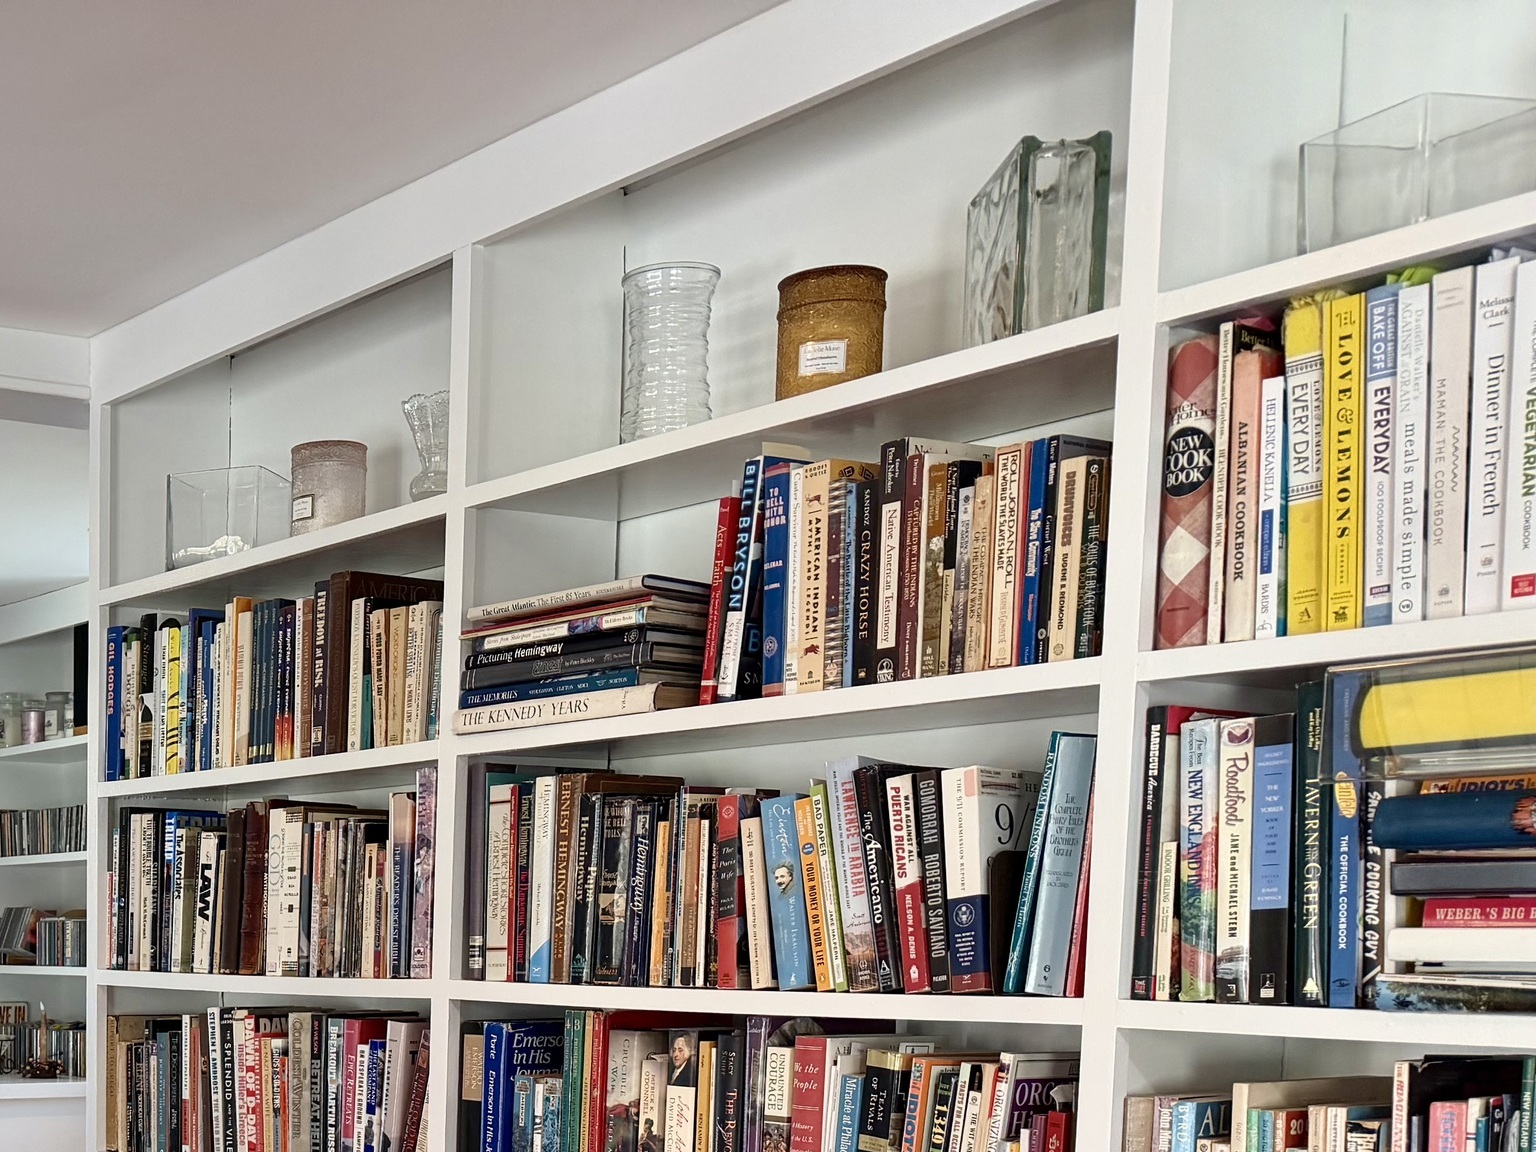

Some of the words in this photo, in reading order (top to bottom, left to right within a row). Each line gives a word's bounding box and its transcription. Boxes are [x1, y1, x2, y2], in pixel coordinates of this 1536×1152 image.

[1373, 306, 1385, 339] BAKE
[1483, 308, 1509, 319] Clark
[1338, 334, 1353, 402] LOVE
[1373, 341, 1385, 370] OFF
[1292, 383, 1309, 435] EVERY
[1486, 354, 1505, 421] Dinner
[1337, 408, 1353, 425] &
[1373, 386, 1390, 475] EVERYDAY
[1485, 426, 1503, 443] in
[1166, 449, 1213, 474] COOK
[1171, 434, 1203, 453] NEW
[1237, 421, 1248, 496] ALBANIAN
[1294, 442, 1309, 474] DAY
[1403, 423, 1419, 474] meals
[742, 465, 756, 509] BILL
[1166, 468, 1205, 487] BOOK
[1336, 428, 1352, 540] LEMONS
[1403, 480, 1417, 526] made
[1482, 450, 1502, 517] French
[888, 509, 897, 533] Native
[1233, 502, 1246, 581] COOKBOOK
[728, 516, 750, 609] BRYSON
[814, 516, 822, 581] AMERICAN
[861, 531, 872, 582] CRAZY
[885, 537, 897, 591] American
[1397, 532, 1416, 590] simple
[812, 586, 820, 633] INDIAN
[858, 586, 870, 640] HORSE
[880, 592, 894, 643] Testimony
[477, 652, 512, 665] Picturing
[514, 643, 564, 659] Hemingway
[106, 664, 115, 717] HODGES
[462, 713, 484, 726] THE
[487, 706, 545, 725] KENNEDY
[551, 698, 590, 715] YEARS
[560, 780, 571, 836] ERNEST
[813, 799, 823, 820] BAD
[890, 786, 904, 832] PUERTO
[919, 779, 938, 844] GOMORRAH
[1225, 752, 1248, 826] Roadfood
[1306, 778, 1320, 846] TAVERN
[817, 824, 827, 857] PAPER
[895, 835, 907, 879] RICANS
[1339, 835, 1347, 849] THE
[198, 863, 213, 921] LAW
[554, 841, 568, 930] HEMINGWAY
[631, 837, 649, 917] Hemingway
[924, 853, 941, 906] ROBERTO
[1303, 862, 1321, 929] GREEN
[1340, 851, 1348, 895] OFFICIAL
[1366, 862, 1381, 925] COOKING
[928, 909, 944, 959] SAVIANO
[1338, 896, 1347, 949] COOKBOOK
[1365, 930, 1379, 960] GUY
[223, 1042, 233, 1100] SPLENDID
[768, 1052, 778, 1111] COURAGE
[777, 1054, 786, 1111] UNDAUNTED
[845, 1078, 857, 1112] Miracle
[843, 1114, 852, 1125] at
[1177, 1105, 1188, 1142] BYRD
